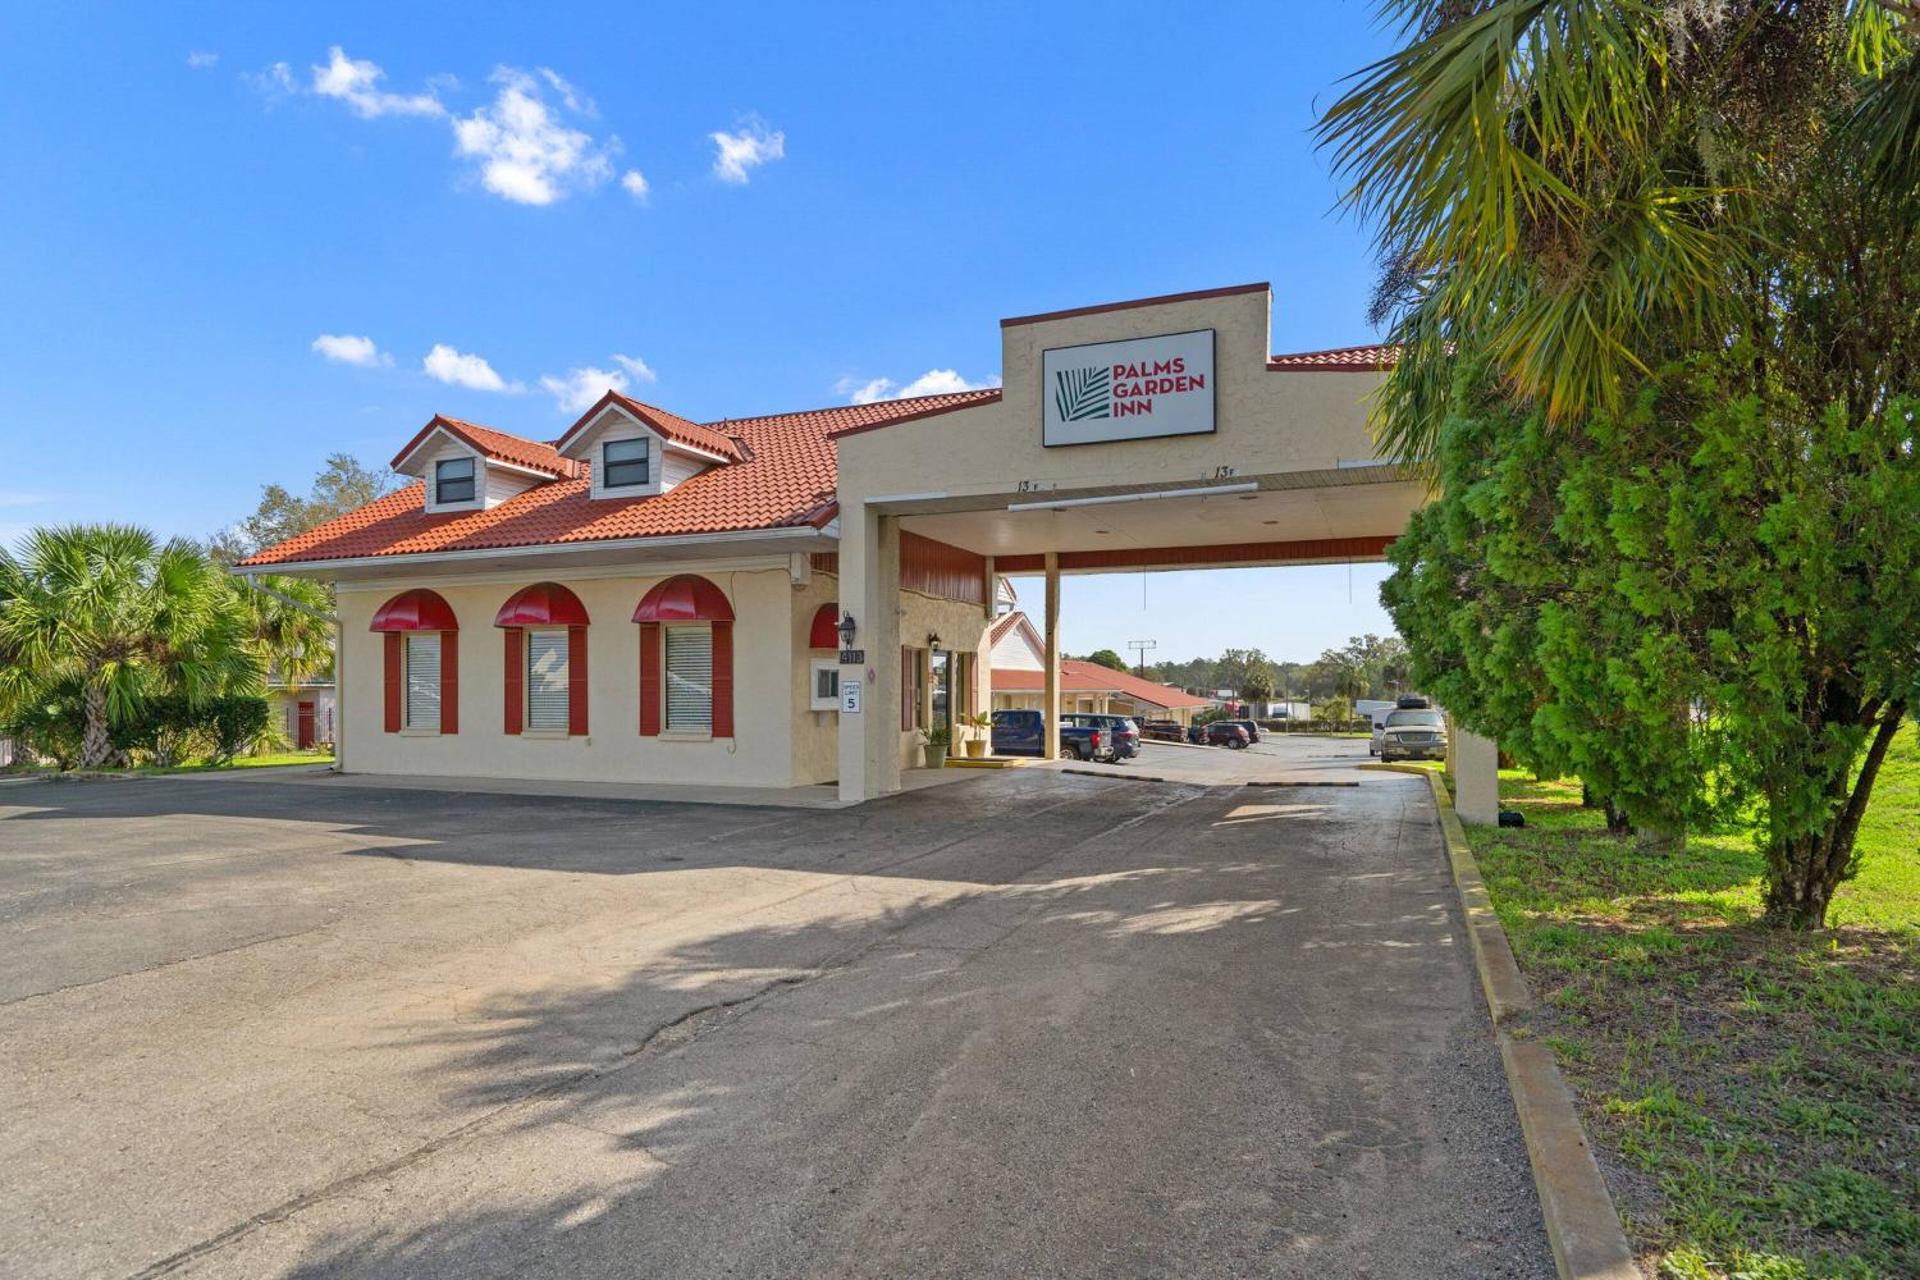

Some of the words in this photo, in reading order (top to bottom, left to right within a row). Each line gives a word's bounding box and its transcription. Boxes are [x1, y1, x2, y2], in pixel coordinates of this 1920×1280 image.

[1113, 357, 1184, 380] PALMS
[1113, 374, 1205, 398] GARDEN
[1113, 399, 1152, 417] INN
[847, 698, 856, 709] 5
